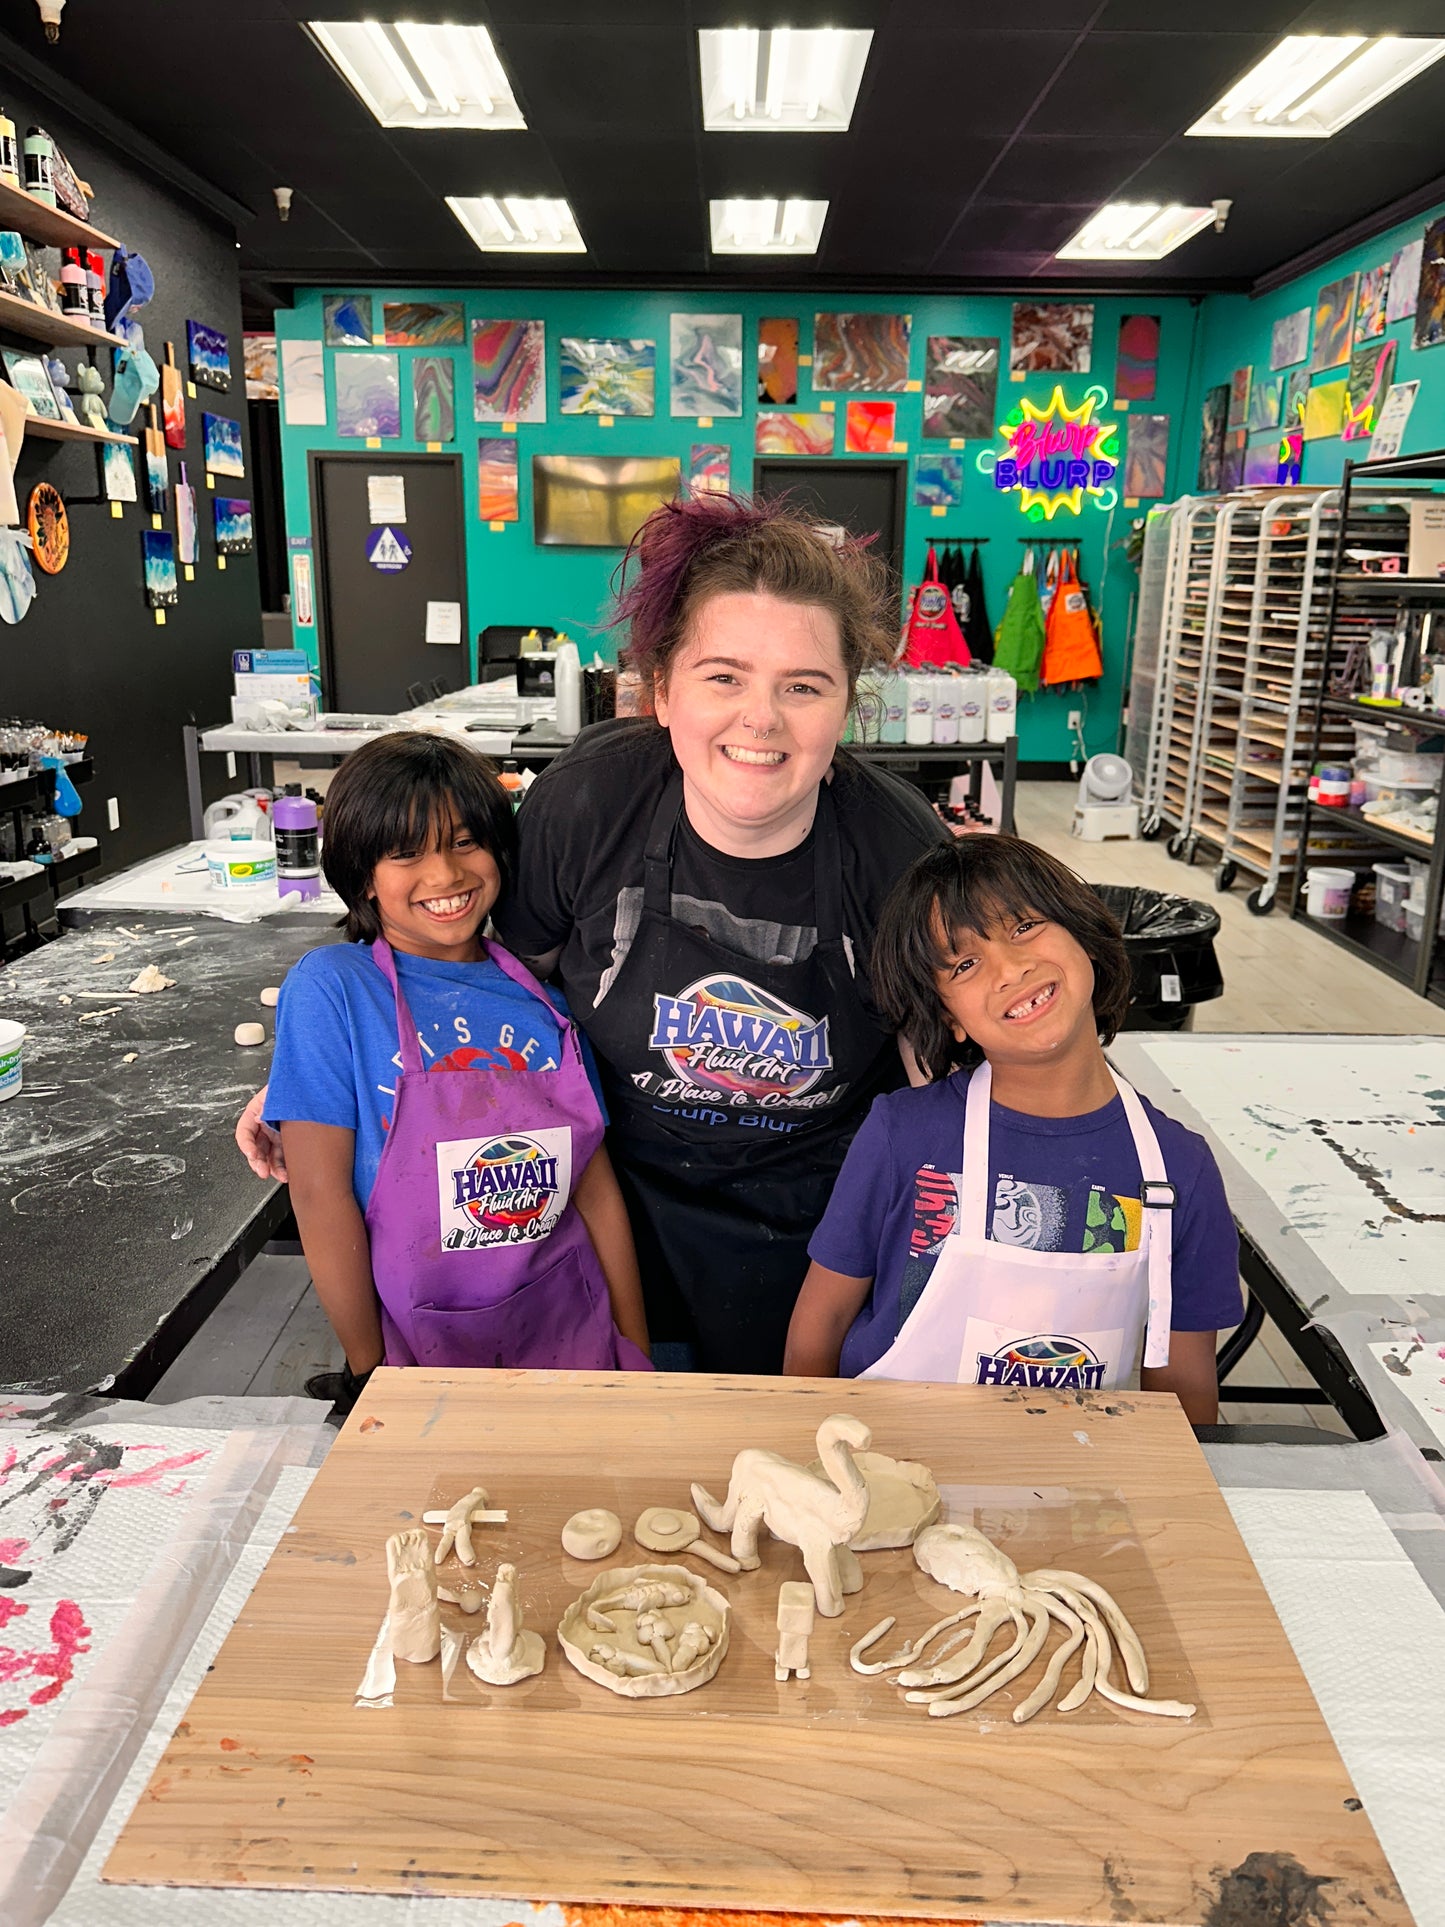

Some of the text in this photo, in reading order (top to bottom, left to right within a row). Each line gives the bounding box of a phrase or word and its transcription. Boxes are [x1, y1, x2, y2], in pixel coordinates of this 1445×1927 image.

[1009, 421, 1100, 469] Blurp
[995, 458, 1115, 489] BLURP
[290, 537, 307, 545] EXIT
[499, 1024, 558, 1073] GET
[650, 993, 832, 1070] HAWAII
[687, 1041, 802, 1084] Fluid Art
[630, 1071, 839, 1109] A Place to Create!
[652, 1104, 814, 1134] urp Blur
[451, 1155, 560, 1210] HAWAII
[1091, 1184, 1106, 1192] EARTH
[476, 1188, 544, 1216] Fluid Art
[443, 1228, 459, 1247] A
[463, 1226, 503, 1248] Place
[508, 1222, 520, 1241] to
[976, 1352, 1108, 1390] HAWAII
